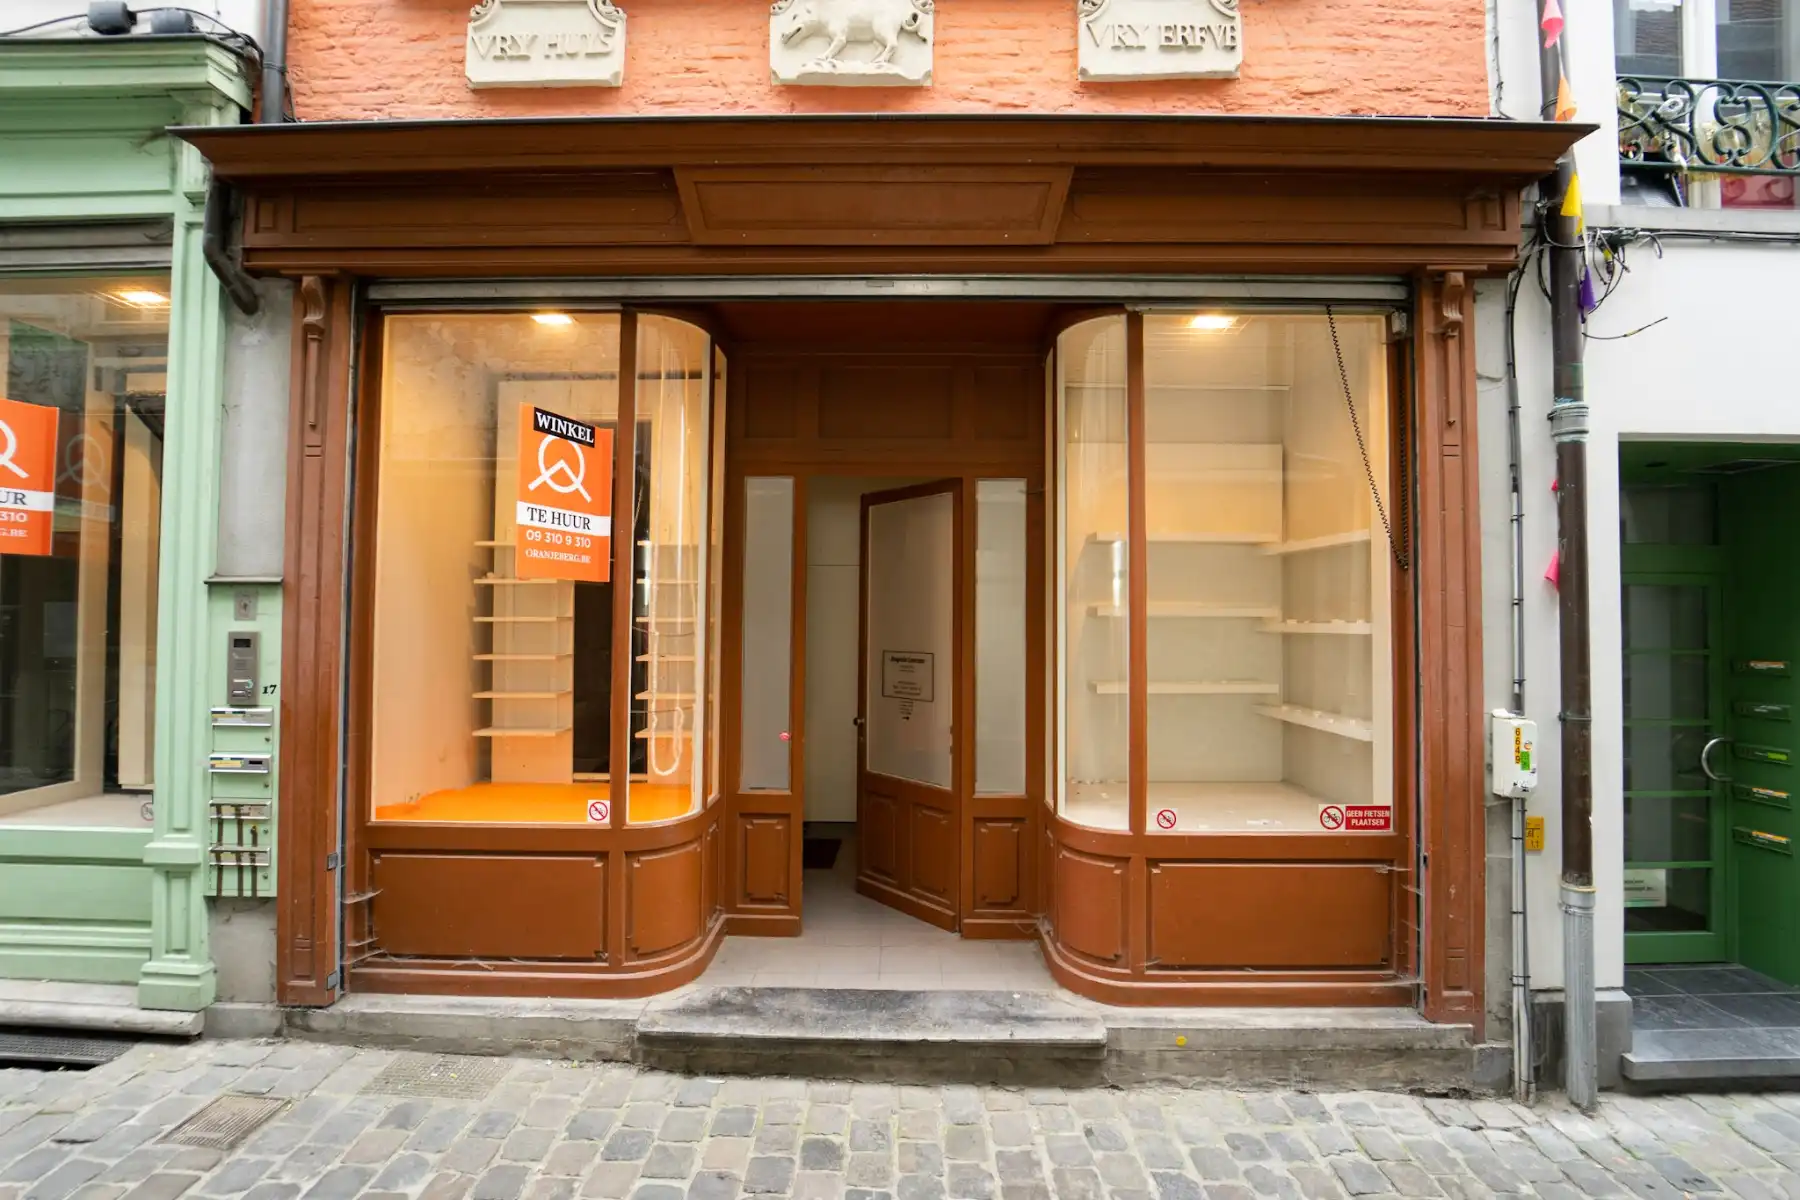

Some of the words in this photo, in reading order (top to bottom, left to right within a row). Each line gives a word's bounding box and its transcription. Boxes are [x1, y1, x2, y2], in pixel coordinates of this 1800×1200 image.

[471, 34, 538, 60] VRY
[1085, 23, 1149, 50] VRY
[535, 411, 594, 444] WINKEL
[526, 506, 547, 523] TE
[551, 511, 592, 530] HUUR
[526, 529, 542, 541] 09
[544, 532, 563, 545] 310
[565, 535, 572, 546] 9
[575, 536, 591, 549] 310
[262, 684, 277, 695] 17
